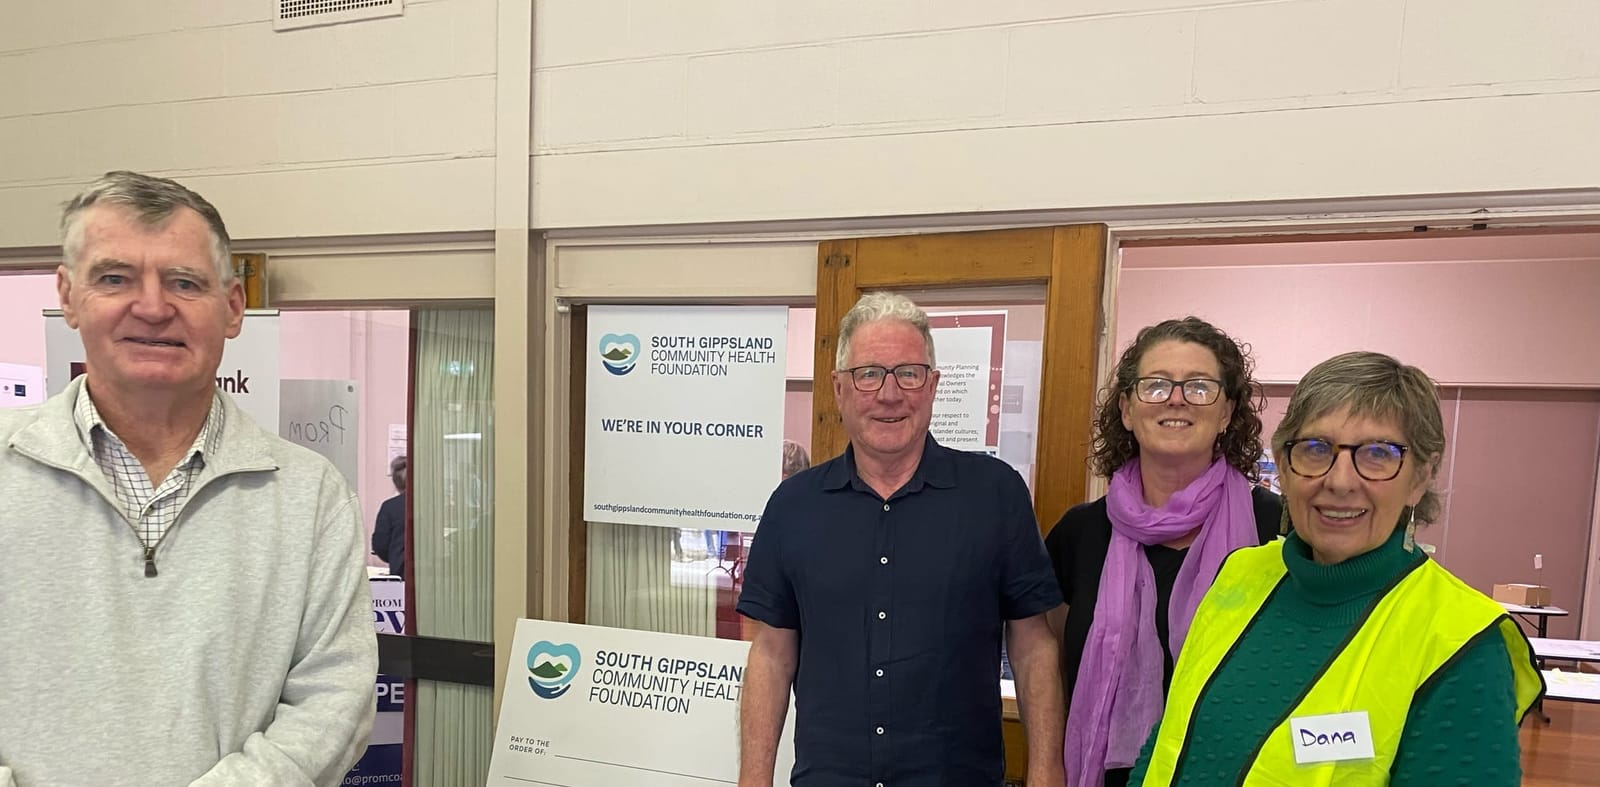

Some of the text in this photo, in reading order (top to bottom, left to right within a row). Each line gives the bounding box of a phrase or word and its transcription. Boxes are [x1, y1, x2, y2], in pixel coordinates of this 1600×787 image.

[651, 336, 773, 349] SOUTH GIPPSLAND
[651, 350, 776, 363] COMMUNITY HEALTH
[651, 363, 728, 376] FOUNDATION
[602, 418, 763, 438] WE'RE IN YOUR CORNER
[595, 650, 744, 682] SOUTH GIPPSLAN
[592, 668, 744, 701] COMMUNITY HEALT
[589, 687, 690, 714] FOUNDATION
[536, 740, 550, 748] THE
[1300, 728, 1356, 747] Dana
[509, 744, 533, 753] ORDER
